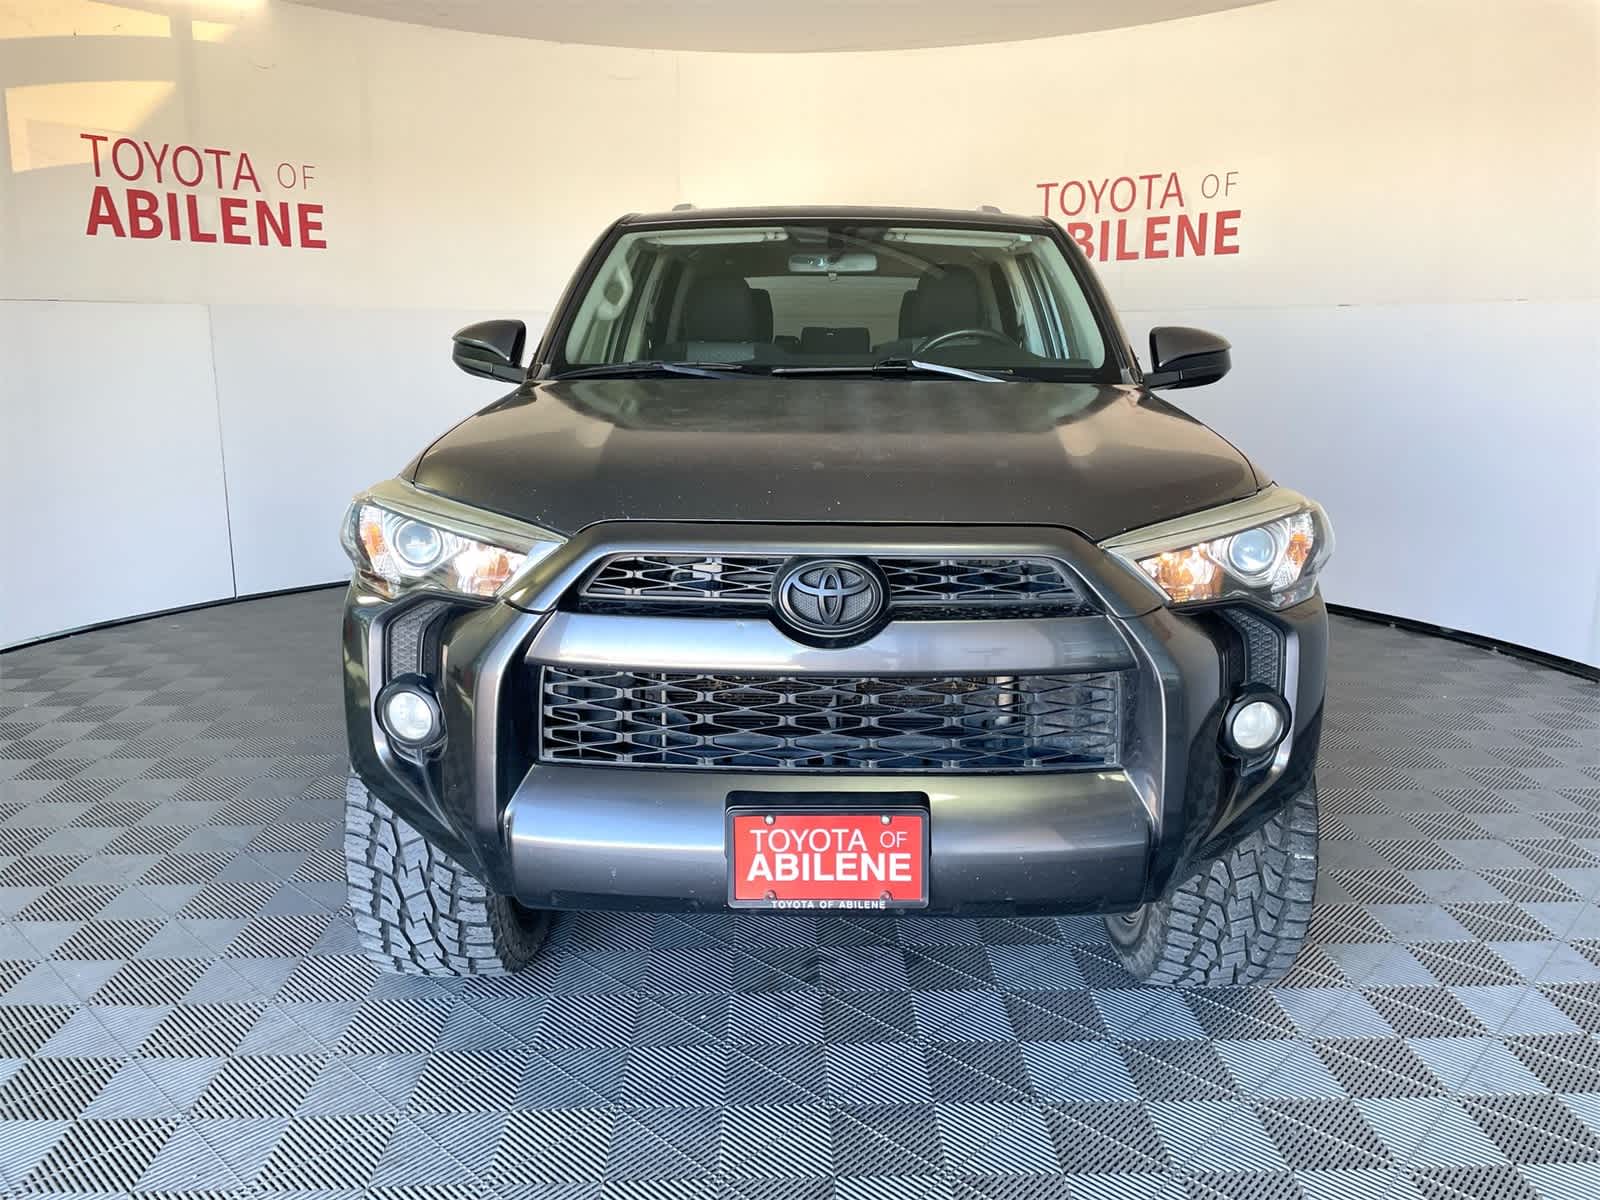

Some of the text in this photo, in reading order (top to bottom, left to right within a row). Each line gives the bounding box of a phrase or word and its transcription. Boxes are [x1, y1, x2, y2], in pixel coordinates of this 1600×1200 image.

[80, 133, 316, 193] TOYOTA OF
[86, 185, 327, 249] ABILENE
[1036, 171, 1239, 217] TOYOTA OF
[1066, 209, 1242, 262] BILENE
[749, 828, 908, 852] TOYOTA OF
[746, 852, 912, 882] ABILENE
[771, 900, 887, 910] TOYOTA OF ABILENE
